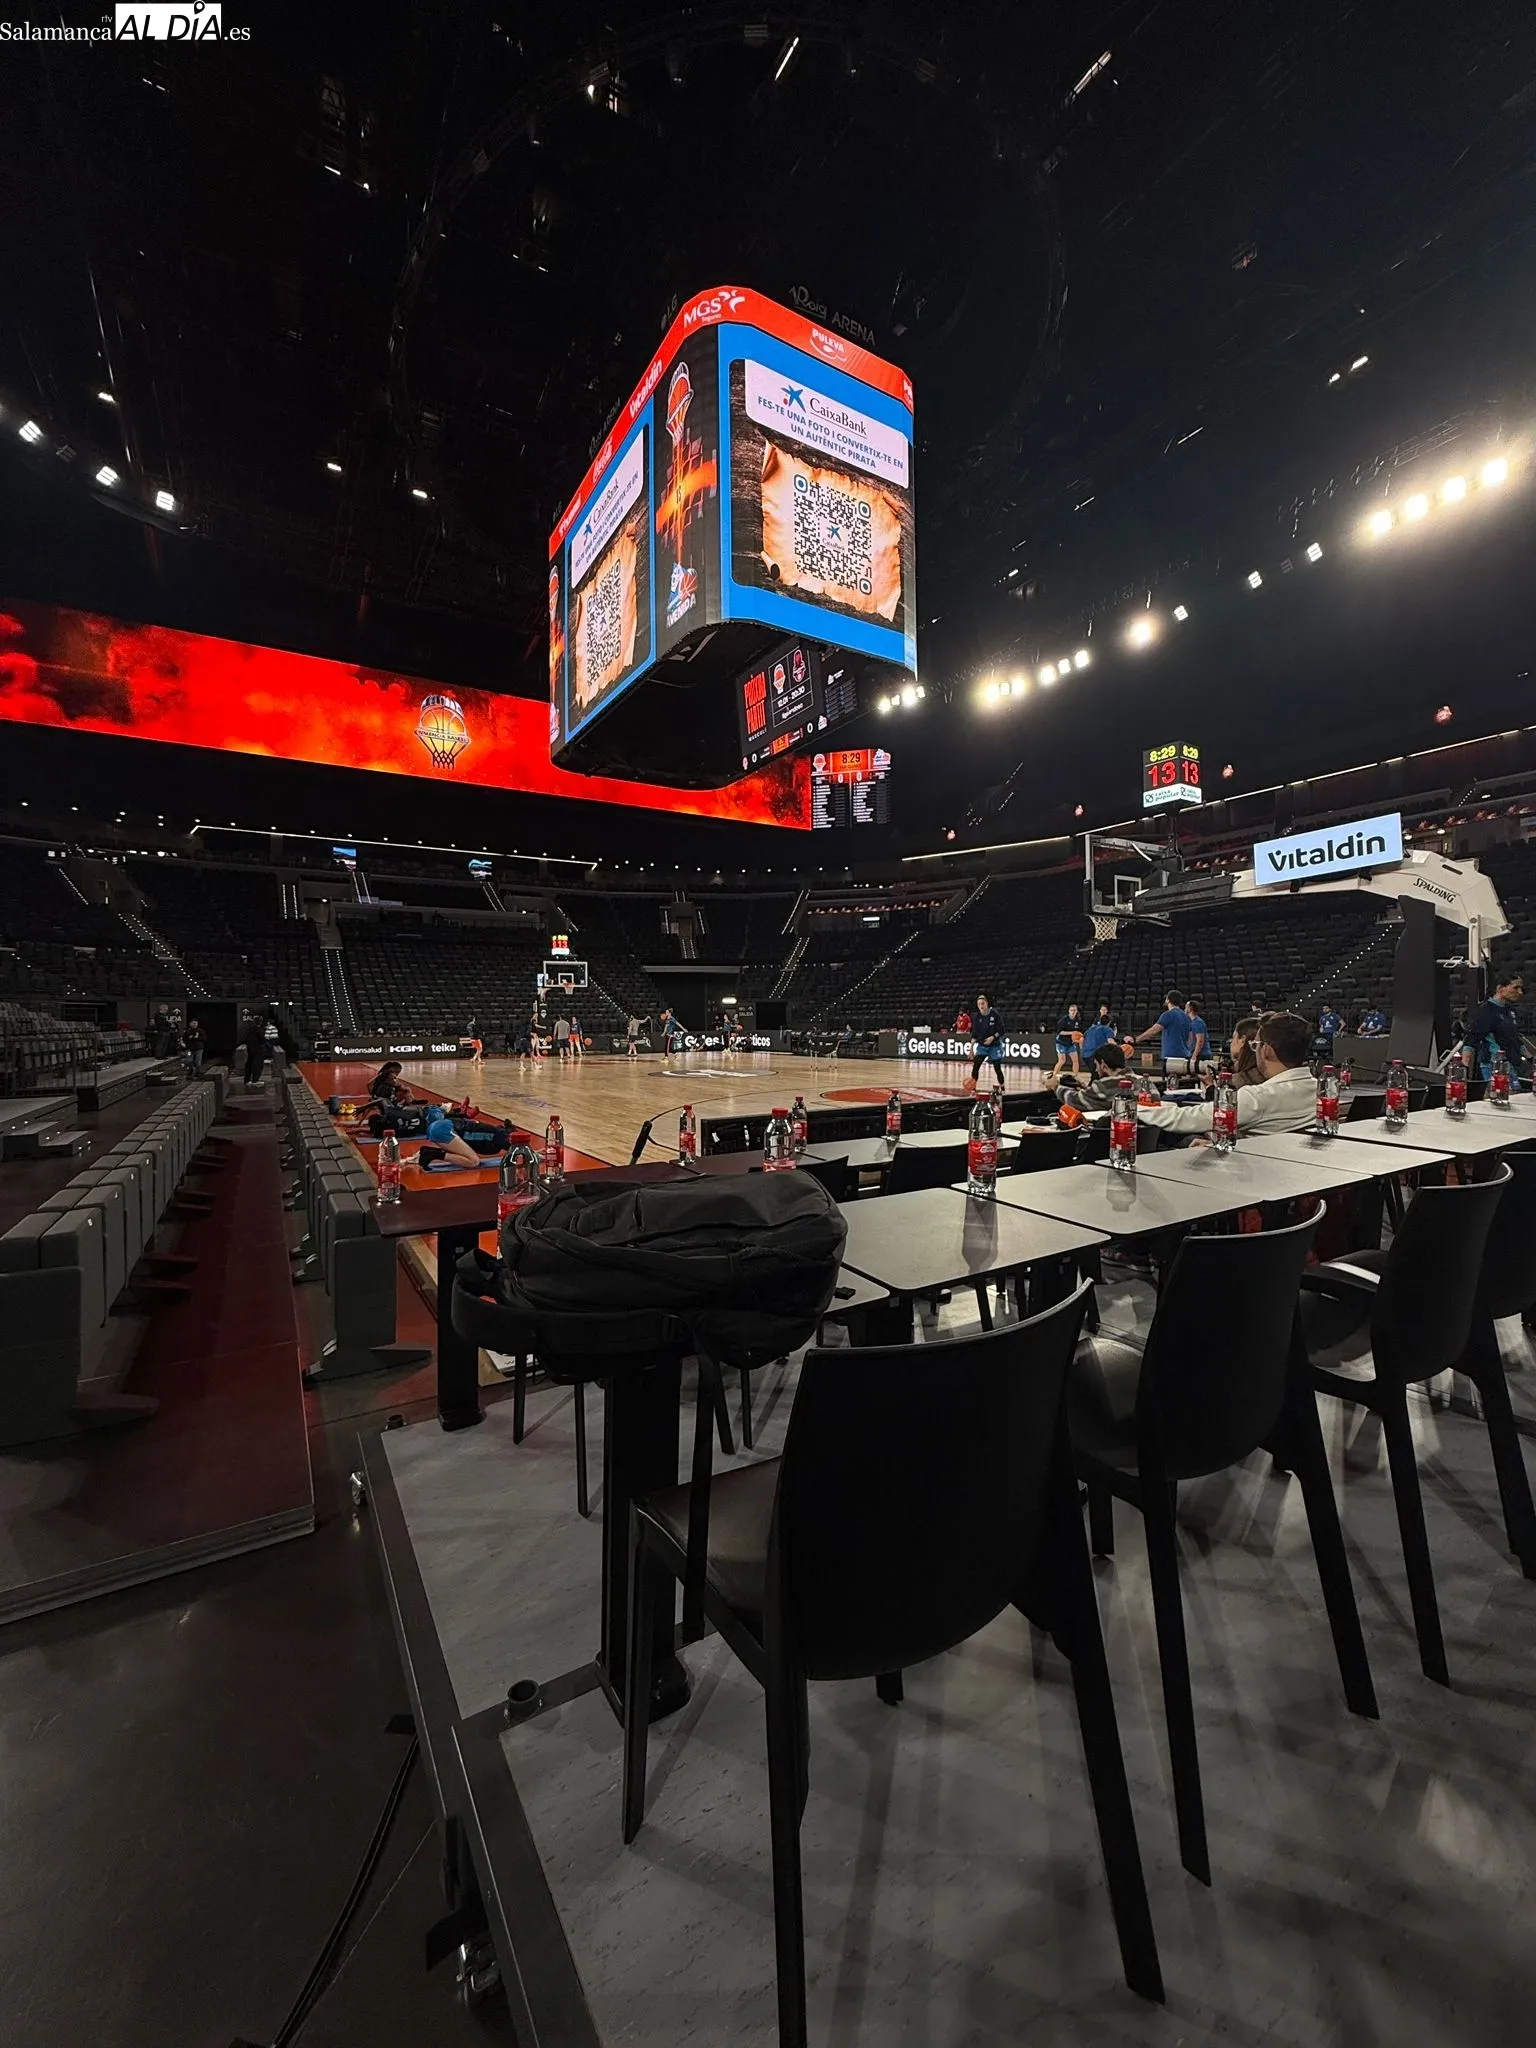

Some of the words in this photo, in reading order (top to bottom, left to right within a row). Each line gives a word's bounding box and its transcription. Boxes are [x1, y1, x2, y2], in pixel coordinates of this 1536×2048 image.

[684, 298, 721, 328] MGS
[812, 328, 845, 353] PULEVA
[832, 312, 876, 346] ARENA
[810, 397, 868, 436] CaixaBank
[758, 396, 785, 416] FES-TE
[787, 410, 807, 427] UNA
[808, 416, 831, 437] FOTO
[837, 432, 893, 463] CONVERTIX-TE
[893, 458, 904, 470] EN
[790, 423, 806, 437] UN
[806, 430, 847, 457] AUTÈNTIC
[847, 450, 876, 470] PIRATA
[842, 752, 861, 764] 8:29
[1150, 745, 1176, 762] 8:29
[838, 773, 844, 783] 0
[856, 771, 862, 781] 0
[1148, 761, 1176, 787] 13
[1182, 760, 1199, 784] 13
[1413, 878, 1457, 903] SPALDING
[390, 1045, 423, 1053] KGM
[431, 1043, 457, 1053] teika
[908, 1037, 945, 1055] Geles
